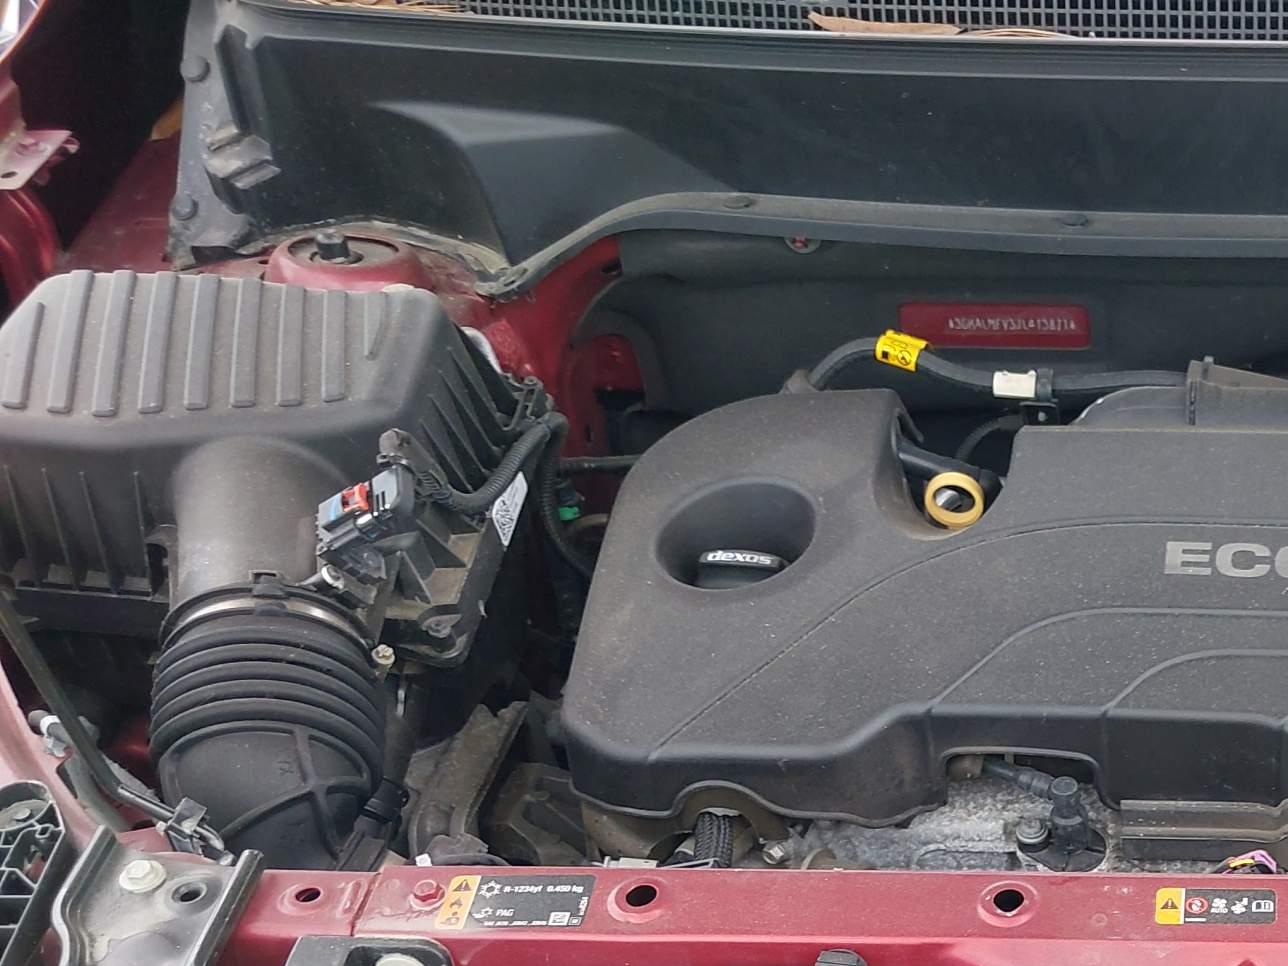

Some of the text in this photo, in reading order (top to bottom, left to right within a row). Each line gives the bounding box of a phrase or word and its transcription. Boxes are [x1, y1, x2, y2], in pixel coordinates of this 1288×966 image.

[706, 549, 773, 565] dexos
[571, 884, 585, 894] kg
[495, 909, 515, 917] PAG
